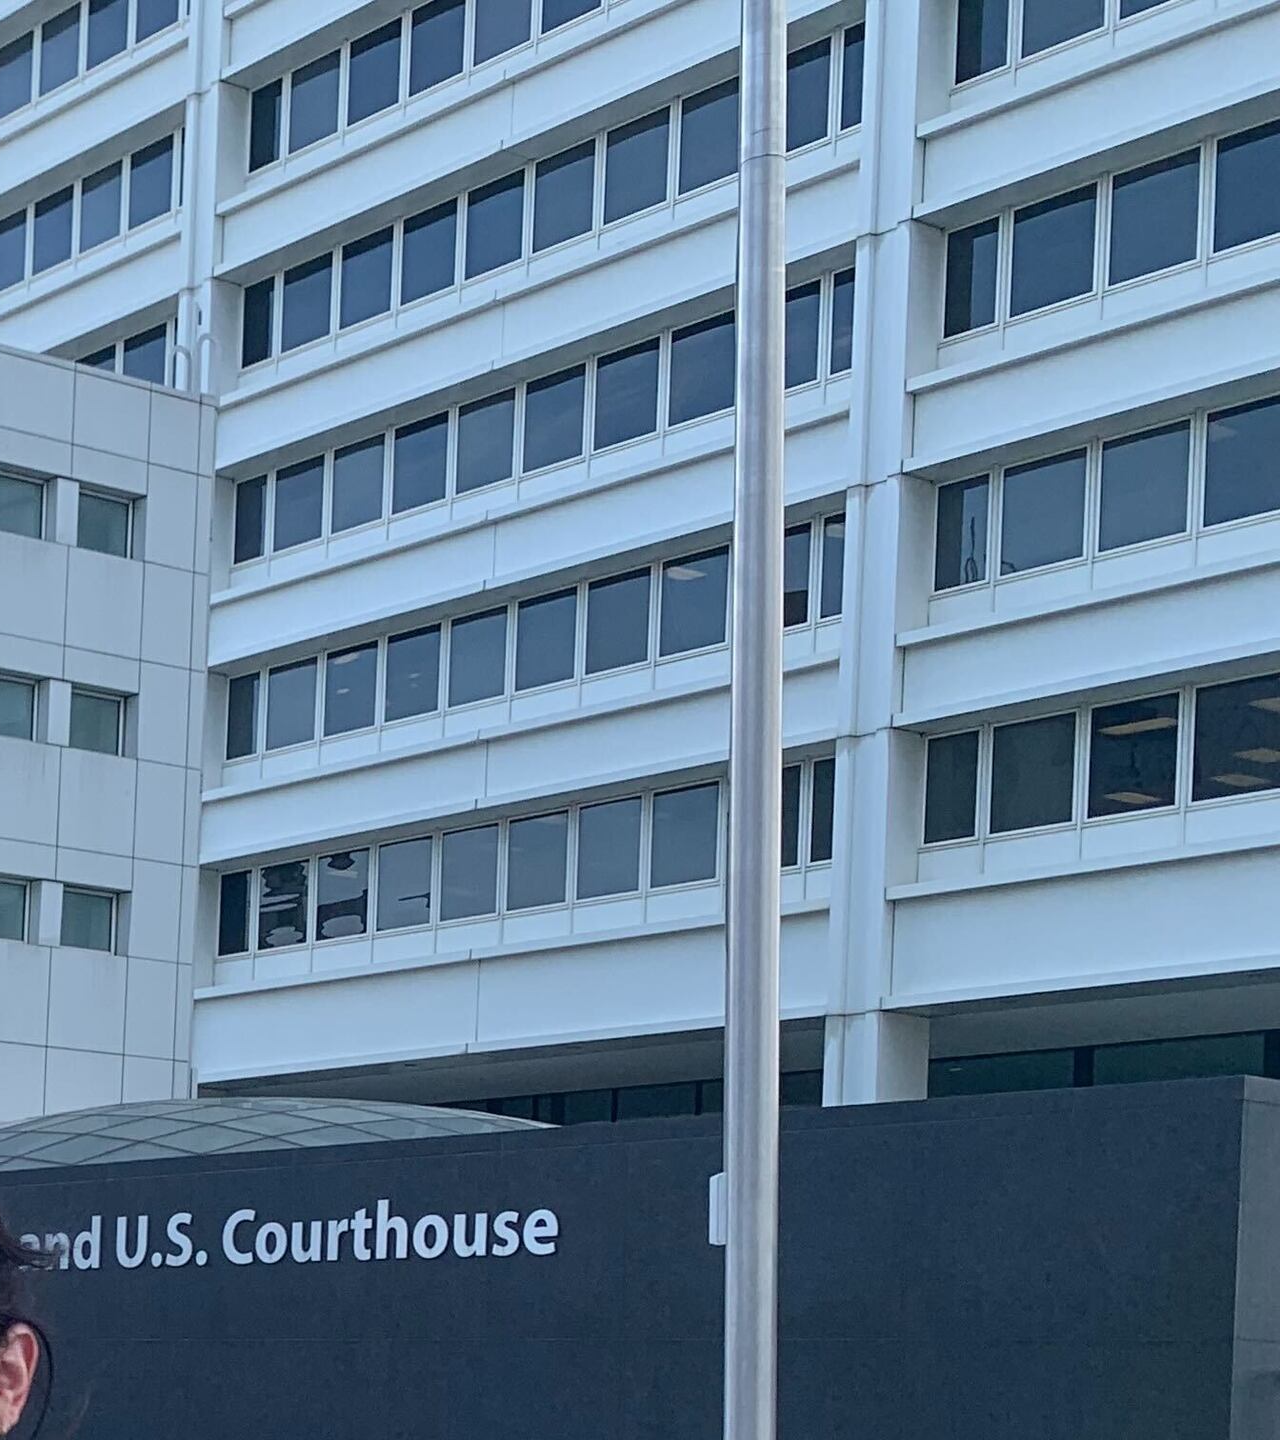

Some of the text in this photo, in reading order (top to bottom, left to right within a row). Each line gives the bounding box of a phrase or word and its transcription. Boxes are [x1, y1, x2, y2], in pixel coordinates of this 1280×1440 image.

[18, 1215, 102, 1272] and
[115, 1209, 208, 1270] U.S.
[221, 1198, 560, 1266] Courthouse
